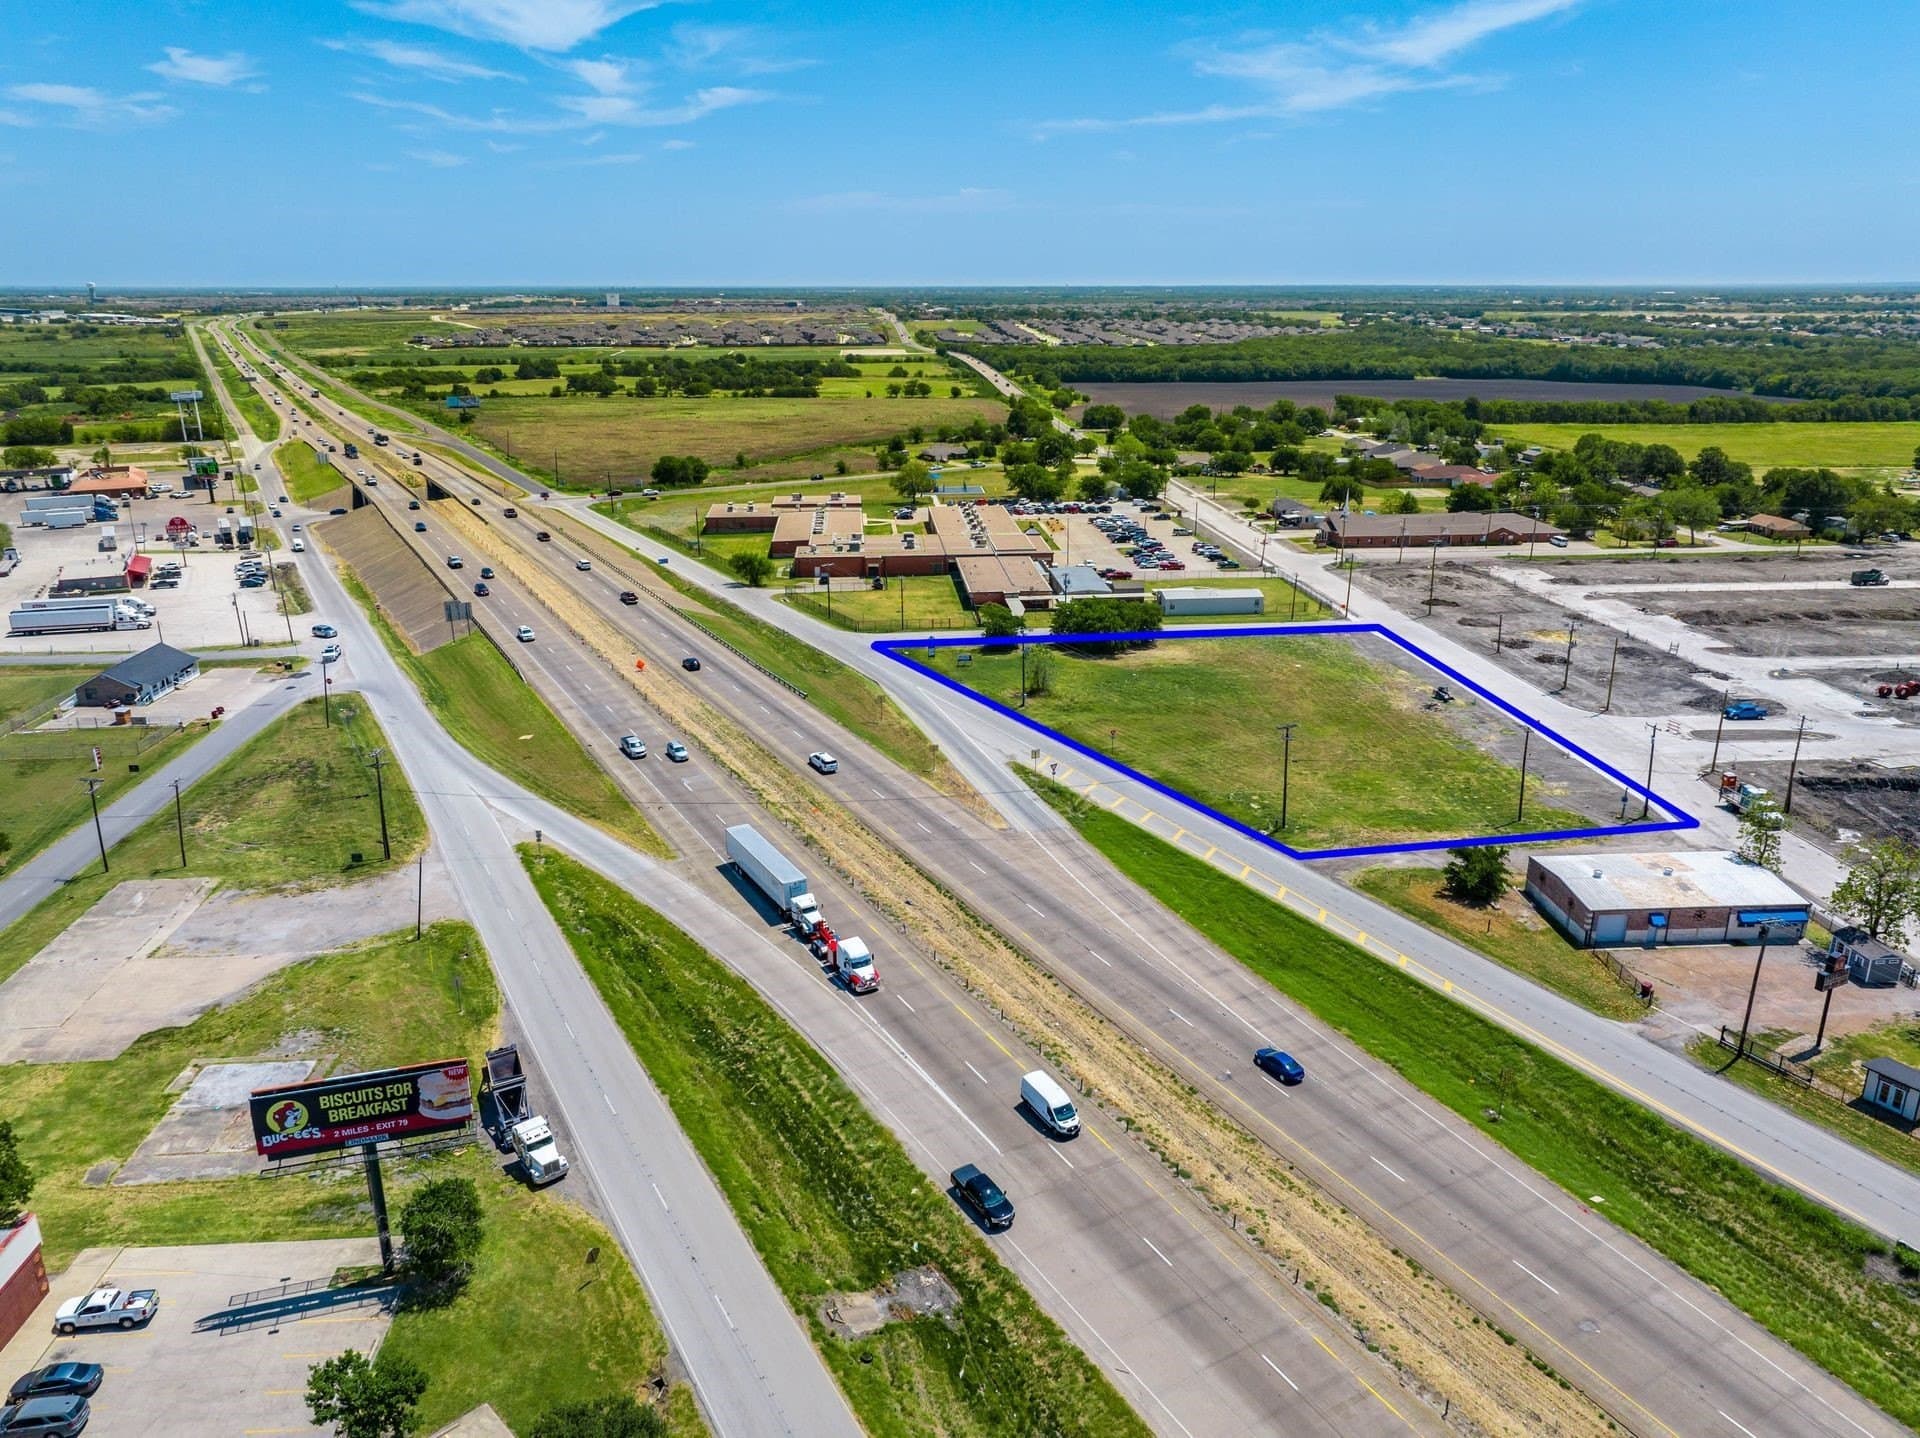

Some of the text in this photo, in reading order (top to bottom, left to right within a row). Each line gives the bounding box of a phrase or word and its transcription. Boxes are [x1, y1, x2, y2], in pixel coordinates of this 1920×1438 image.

[448, 1067, 464, 1076] NEW
[319, 1082, 413, 1109] BISCUITS FOR
[328, 1098, 408, 1123] BREAKFAST
[341, 1125, 369, 1137] MILES
[376, 1121, 397, 1132] EXIT
